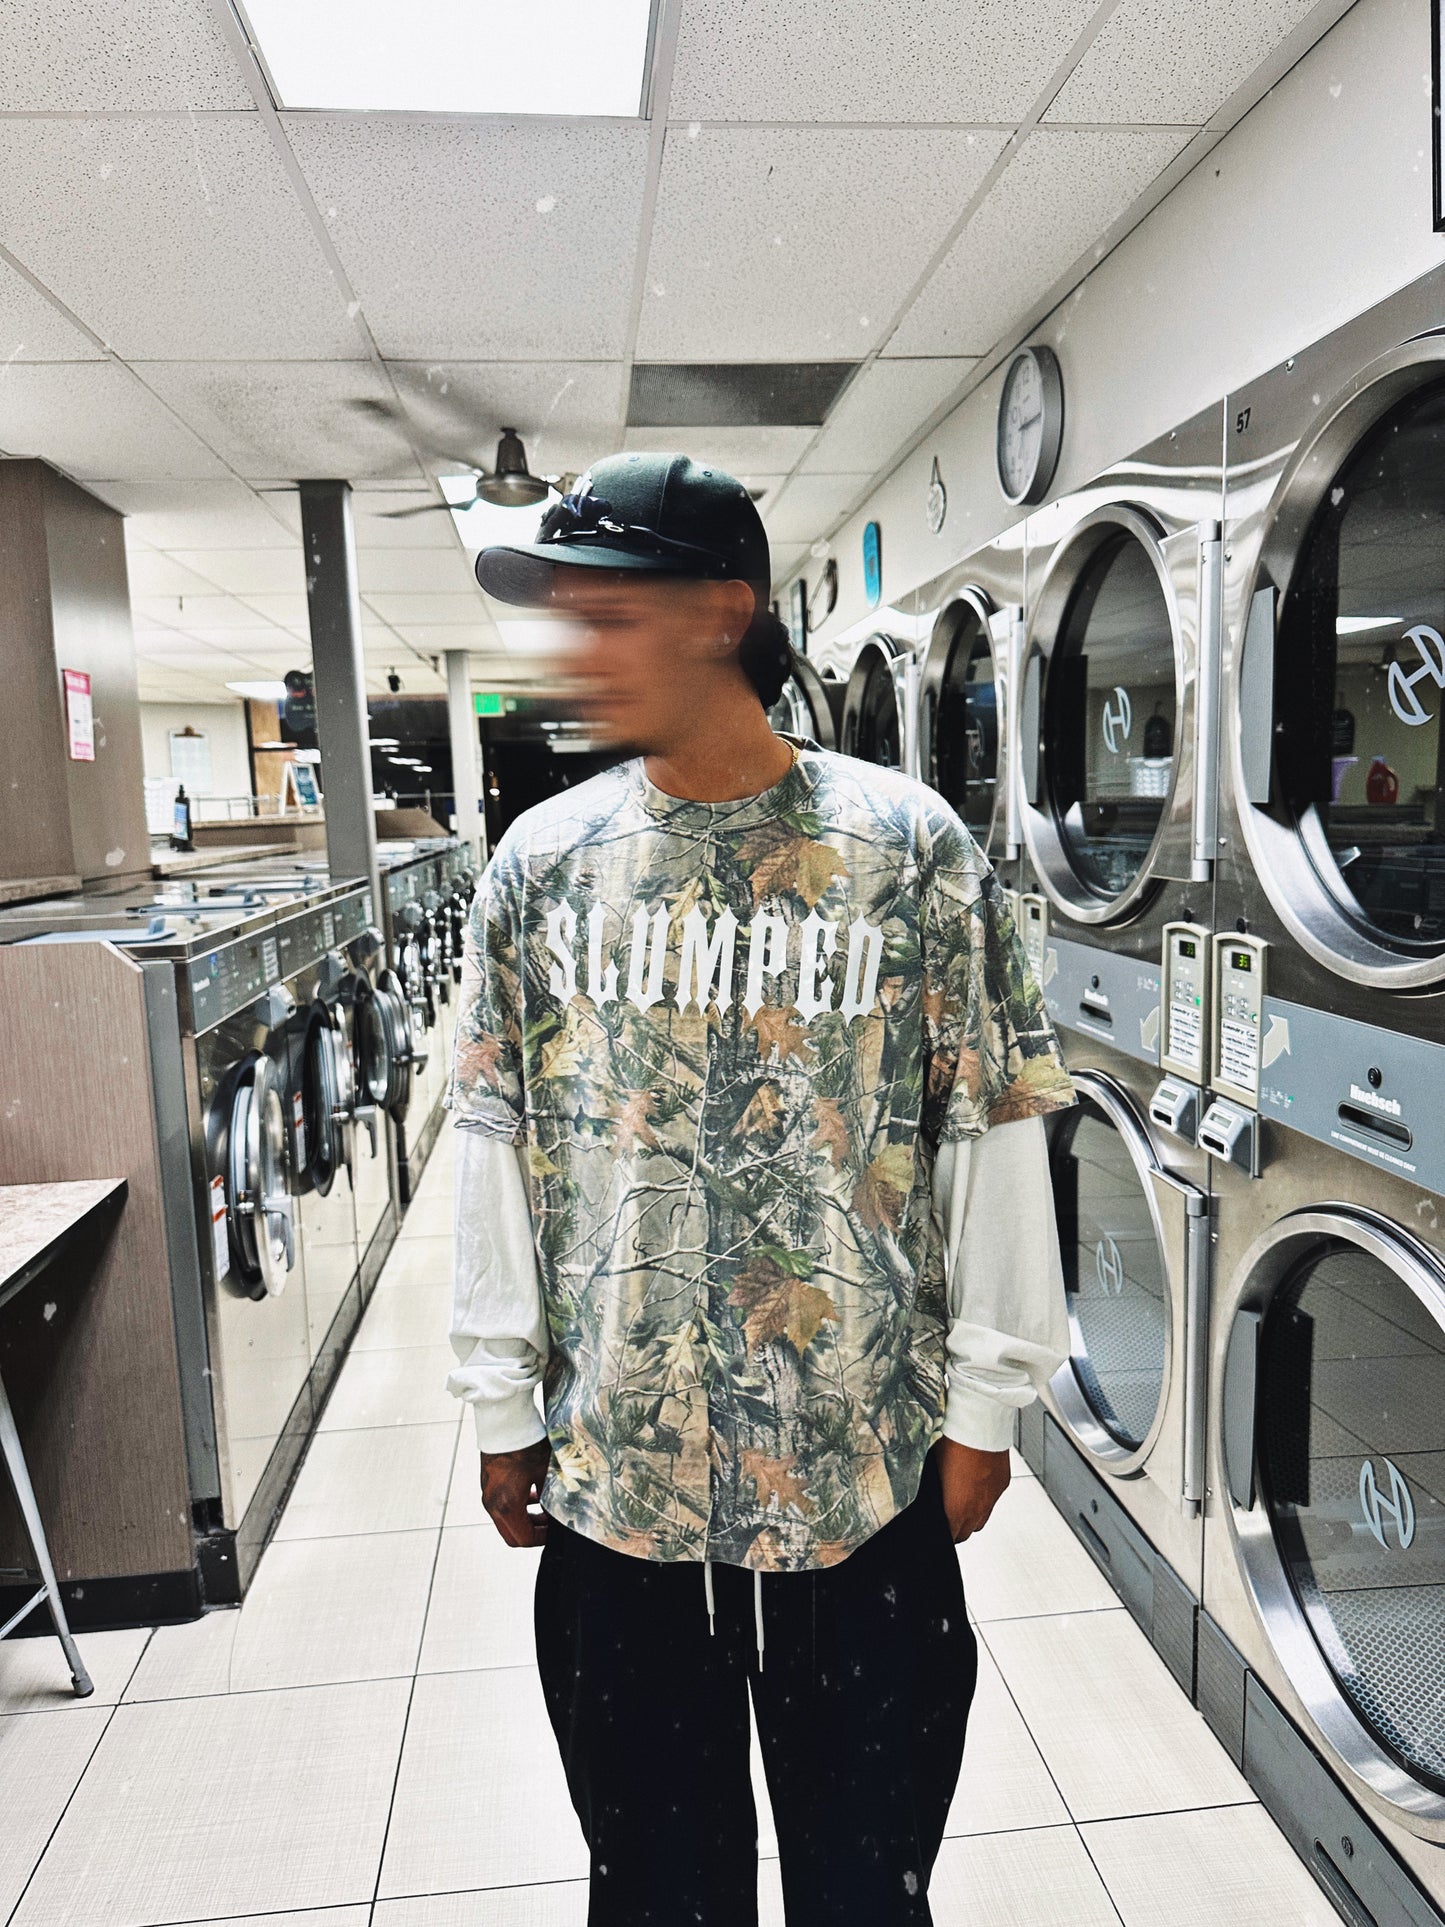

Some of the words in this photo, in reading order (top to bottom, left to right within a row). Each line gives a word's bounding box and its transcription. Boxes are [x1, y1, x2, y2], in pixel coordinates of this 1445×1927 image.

[1236, 406, 1251, 434] 57
[545, 897, 885, 1028] SLUMPED
[1349, 1083, 1401, 1116] Huebsch
